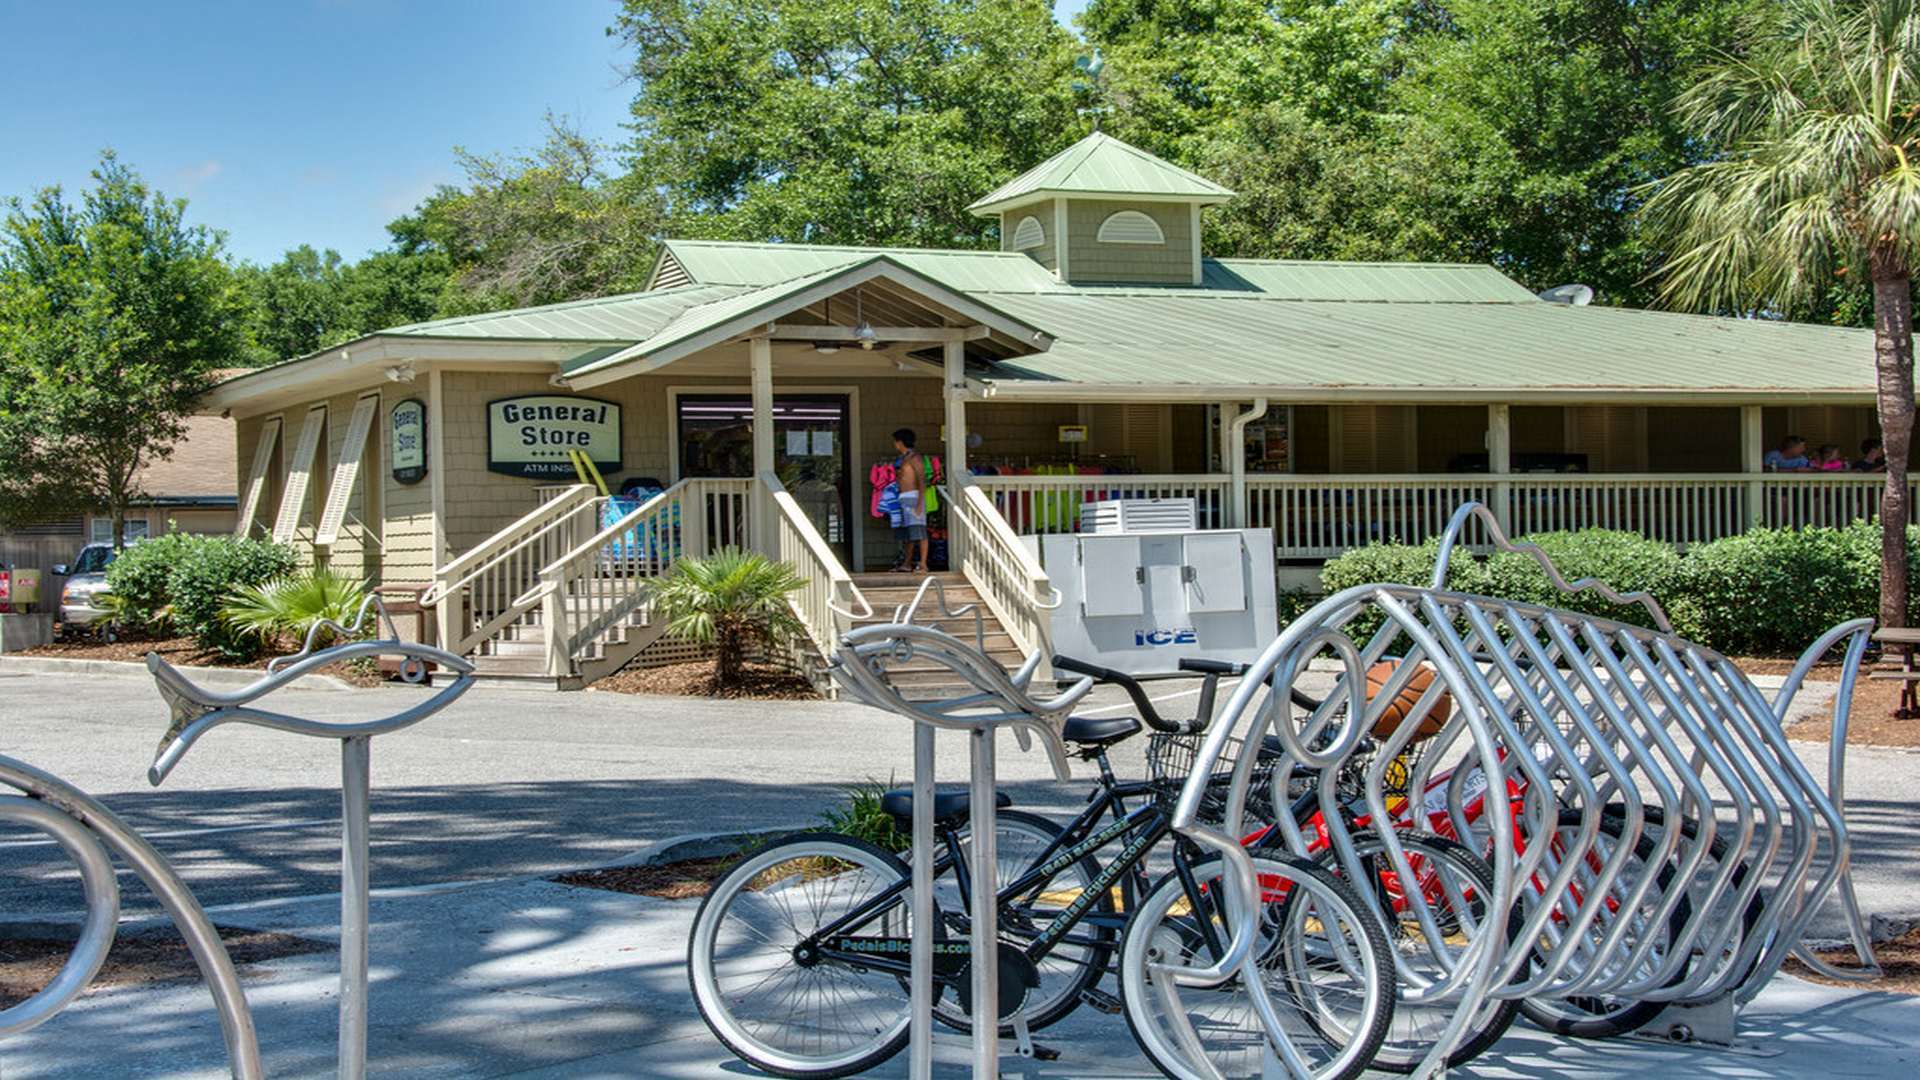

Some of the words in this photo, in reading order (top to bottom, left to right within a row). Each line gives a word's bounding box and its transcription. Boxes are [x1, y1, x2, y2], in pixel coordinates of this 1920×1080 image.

[503, 403, 608, 425] General
[521, 426, 591, 446] Store
[524, 463, 548, 473] ATM
[551, 463, 576, 473] INSI
[1135, 628, 1197, 646] ICE
